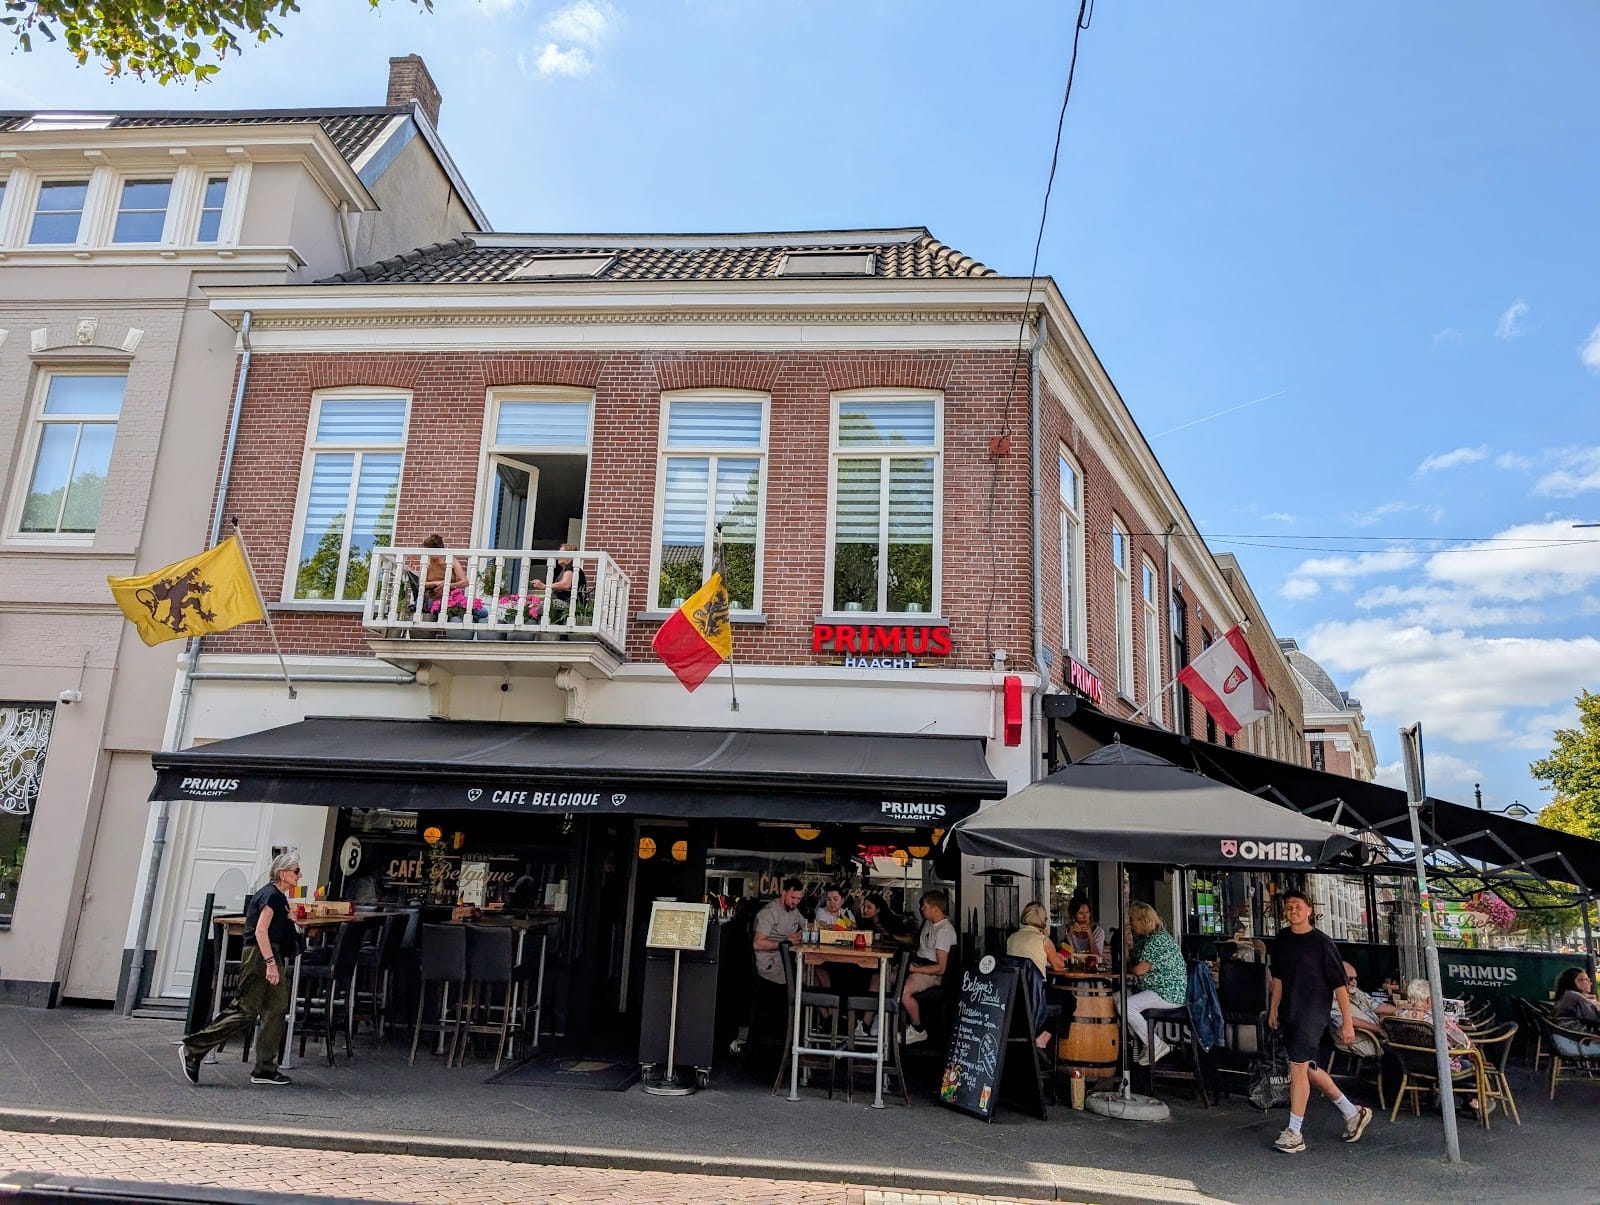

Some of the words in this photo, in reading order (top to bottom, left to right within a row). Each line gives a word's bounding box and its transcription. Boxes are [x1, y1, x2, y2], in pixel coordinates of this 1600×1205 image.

[813, 624, 953, 655] PRIMUS
[844, 656, 917, 669] HAACHT
[1070, 658, 1103, 705] PRIMUS
[180, 777, 240, 791] PRIMUS
[492, 790, 528, 805] CAFE
[531, 792, 600, 807] BELGIQUE
[880, 801, 947, 816] PRIMUS
[348, 848, 359, 870] 8
[1239, 840, 1312, 862] OMER.
[1448, 964, 1518, 982] PRIMUS
[1463, 979, 1503, 988] HAACHT
